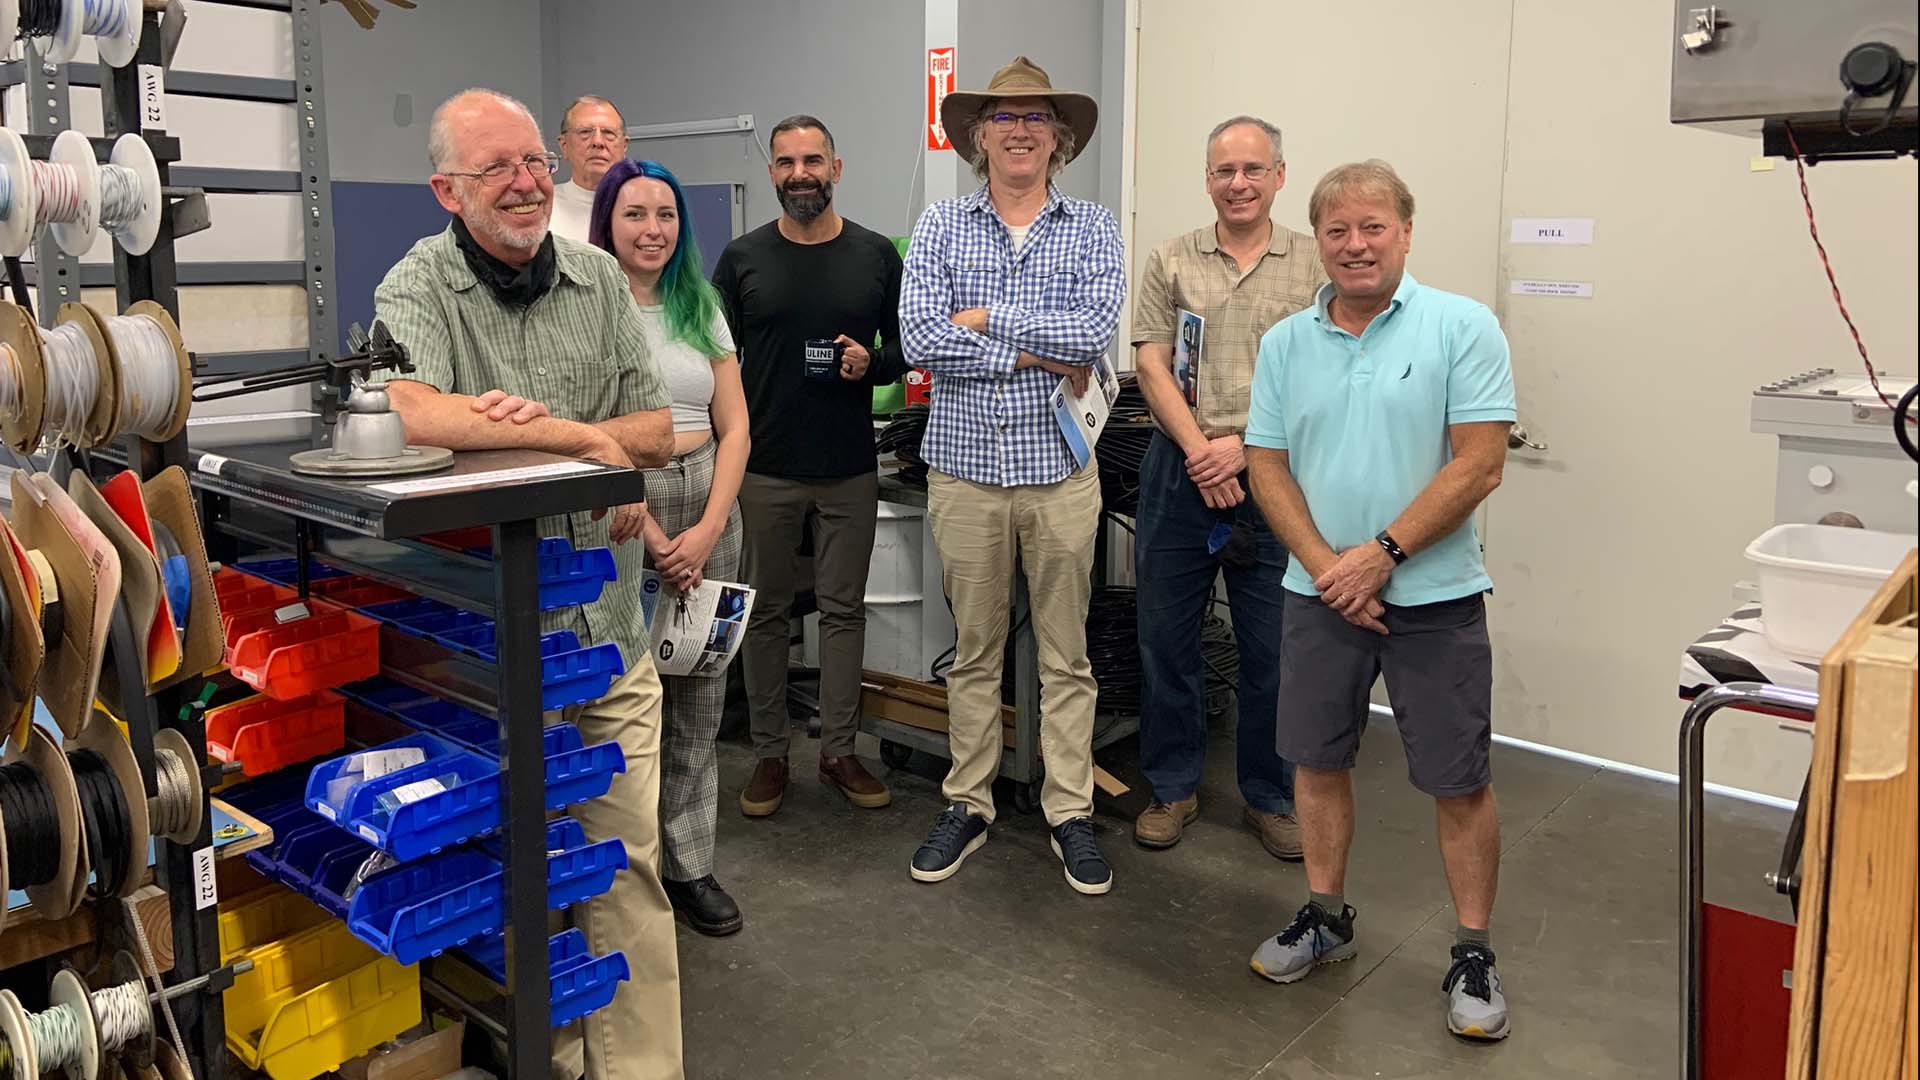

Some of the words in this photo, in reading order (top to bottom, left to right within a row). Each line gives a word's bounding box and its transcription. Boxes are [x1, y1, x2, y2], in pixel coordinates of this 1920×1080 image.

[932, 57, 950, 71] FIRE
[145, 71, 157, 102] AWG
[148, 106, 161, 122] 22
[1538, 229, 1565, 237] PULL
[807, 350, 833, 359] ULINE
[200, 856, 210, 882] AWG
[202, 884, 214, 900] 22
